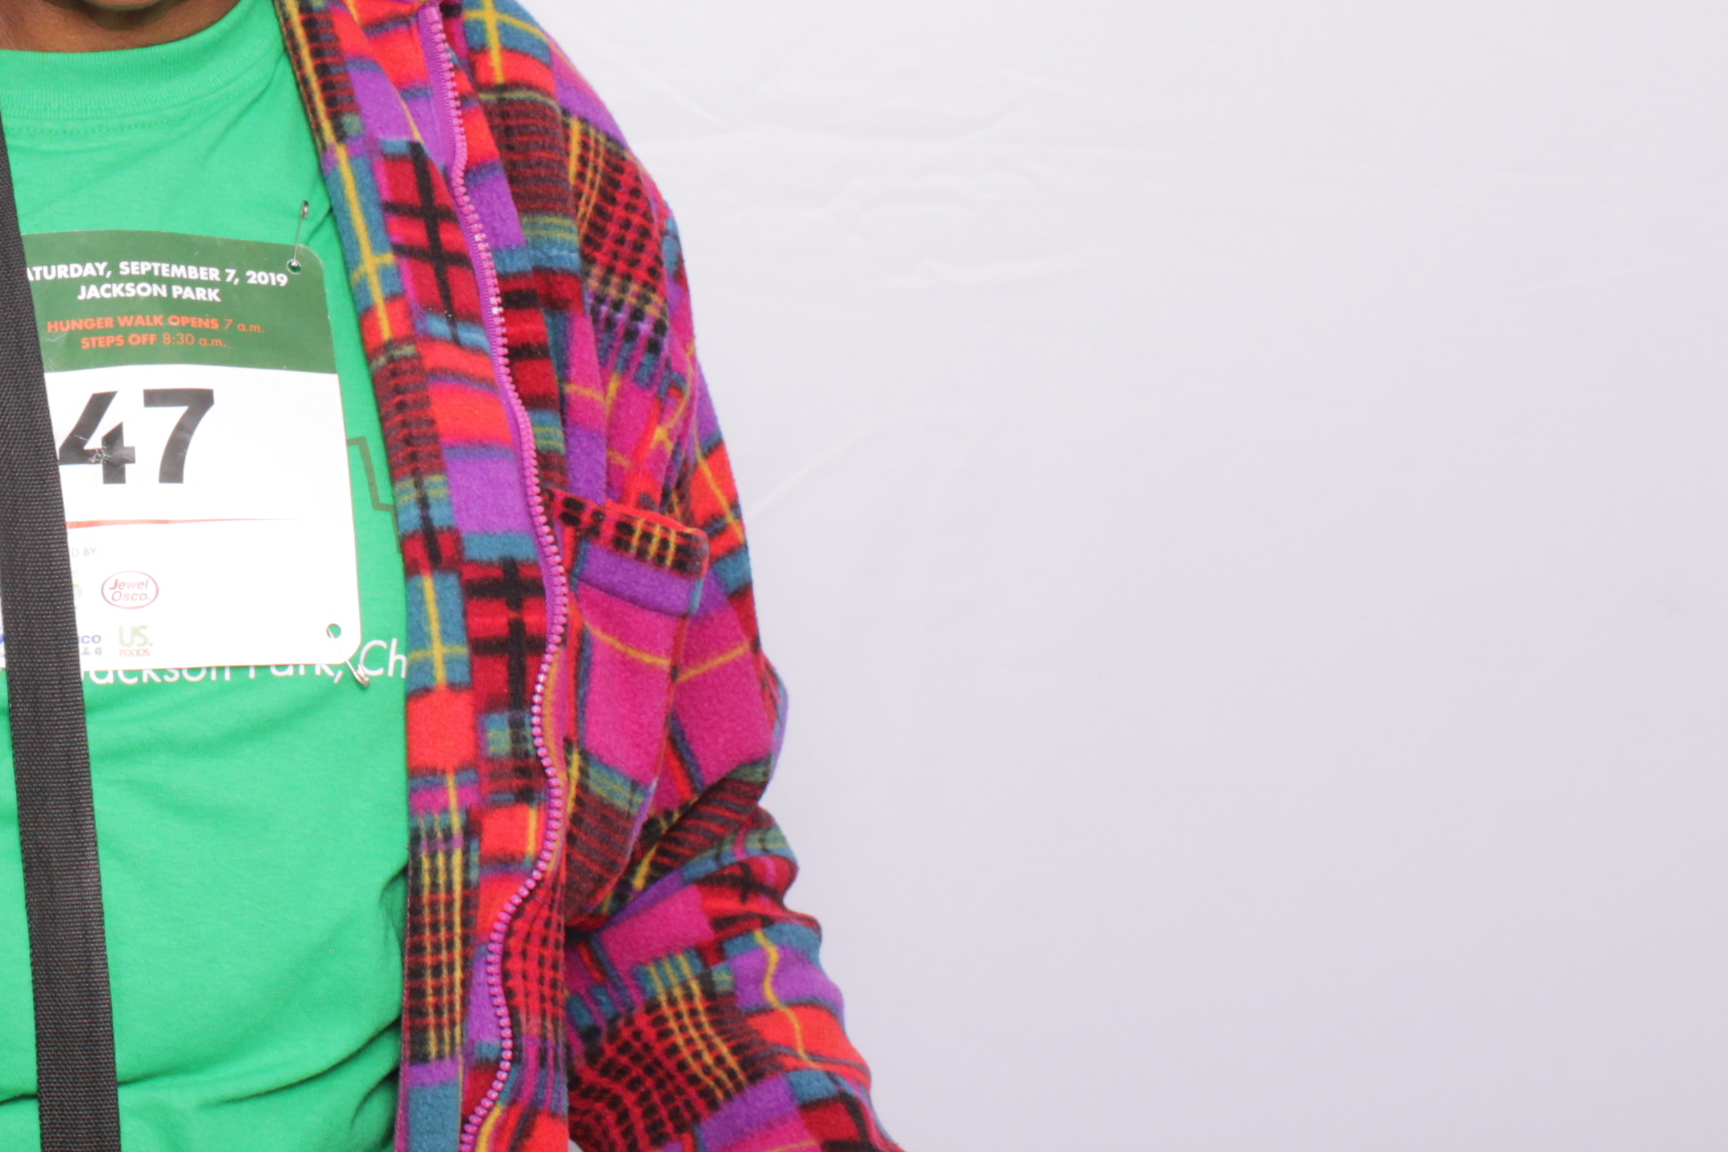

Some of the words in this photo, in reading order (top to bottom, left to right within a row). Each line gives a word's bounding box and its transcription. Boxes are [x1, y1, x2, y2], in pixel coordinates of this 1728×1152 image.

[26, 261, 112, 282] TURDAY,
[119, 261, 221, 282] SEPTEMBER
[225, 268, 240, 285] 7,
[246, 269, 288, 287] 2019
[77, 282, 168, 301] JACKSON
[171, 284, 221, 302] PARK
[46, 315, 114, 333] HUNGER
[117, 314, 165, 328] WALK
[167, 314, 220, 330] OPENS
[223, 318, 233, 330] 7
[236, 322, 265, 333] a.m.
[80, 334, 125, 350] STEPS
[128, 333, 157, 345] OFF
[162, 333, 195, 346] 8:30
[199, 337, 227, 347] a.m.
[108, 578, 149, 590] Jewel
[119, 648, 151, 657] FOODS
